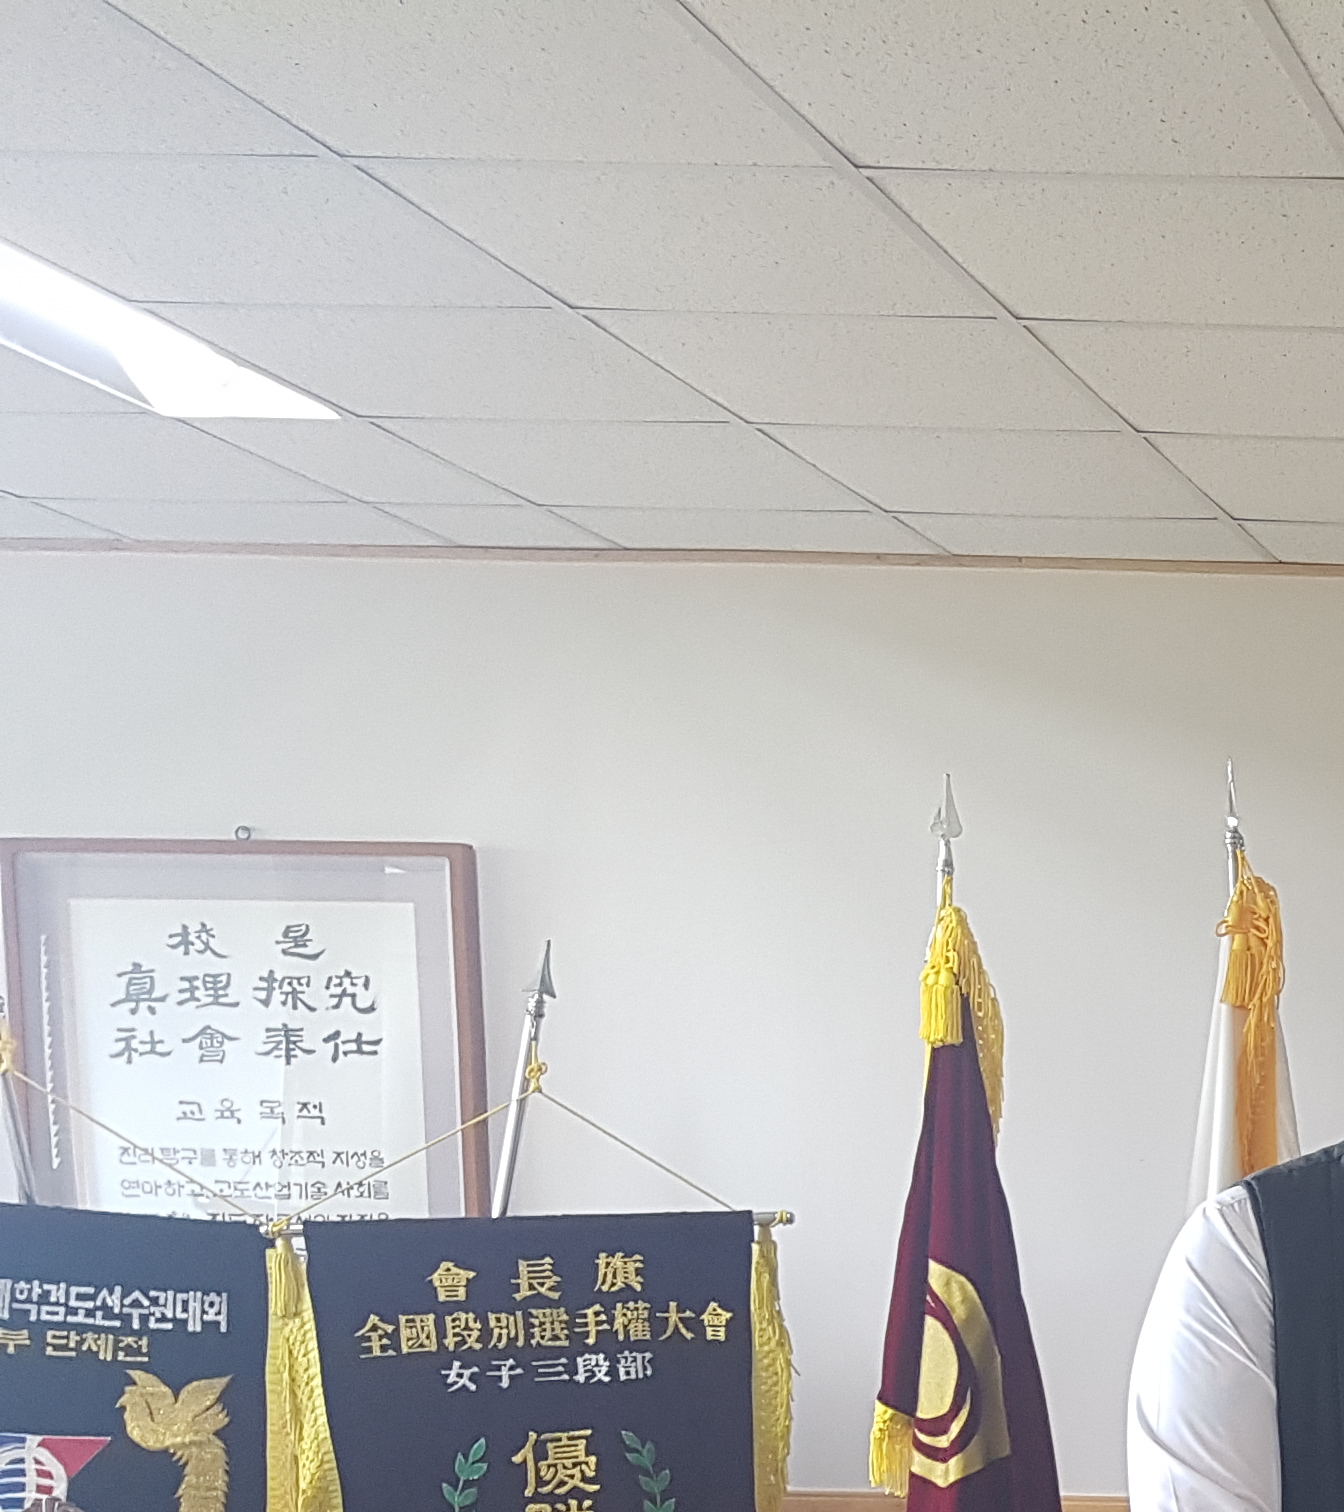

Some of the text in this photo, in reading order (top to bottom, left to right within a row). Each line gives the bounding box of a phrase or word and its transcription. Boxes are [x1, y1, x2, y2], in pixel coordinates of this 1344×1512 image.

[175, 1098, 326, 1126] 교육 목적
[425, 1251, 645, 1303] 會長旗
[45, 1329, 149, 1362] 단체전
[440, 1350, 654, 1393] 女子三段部
